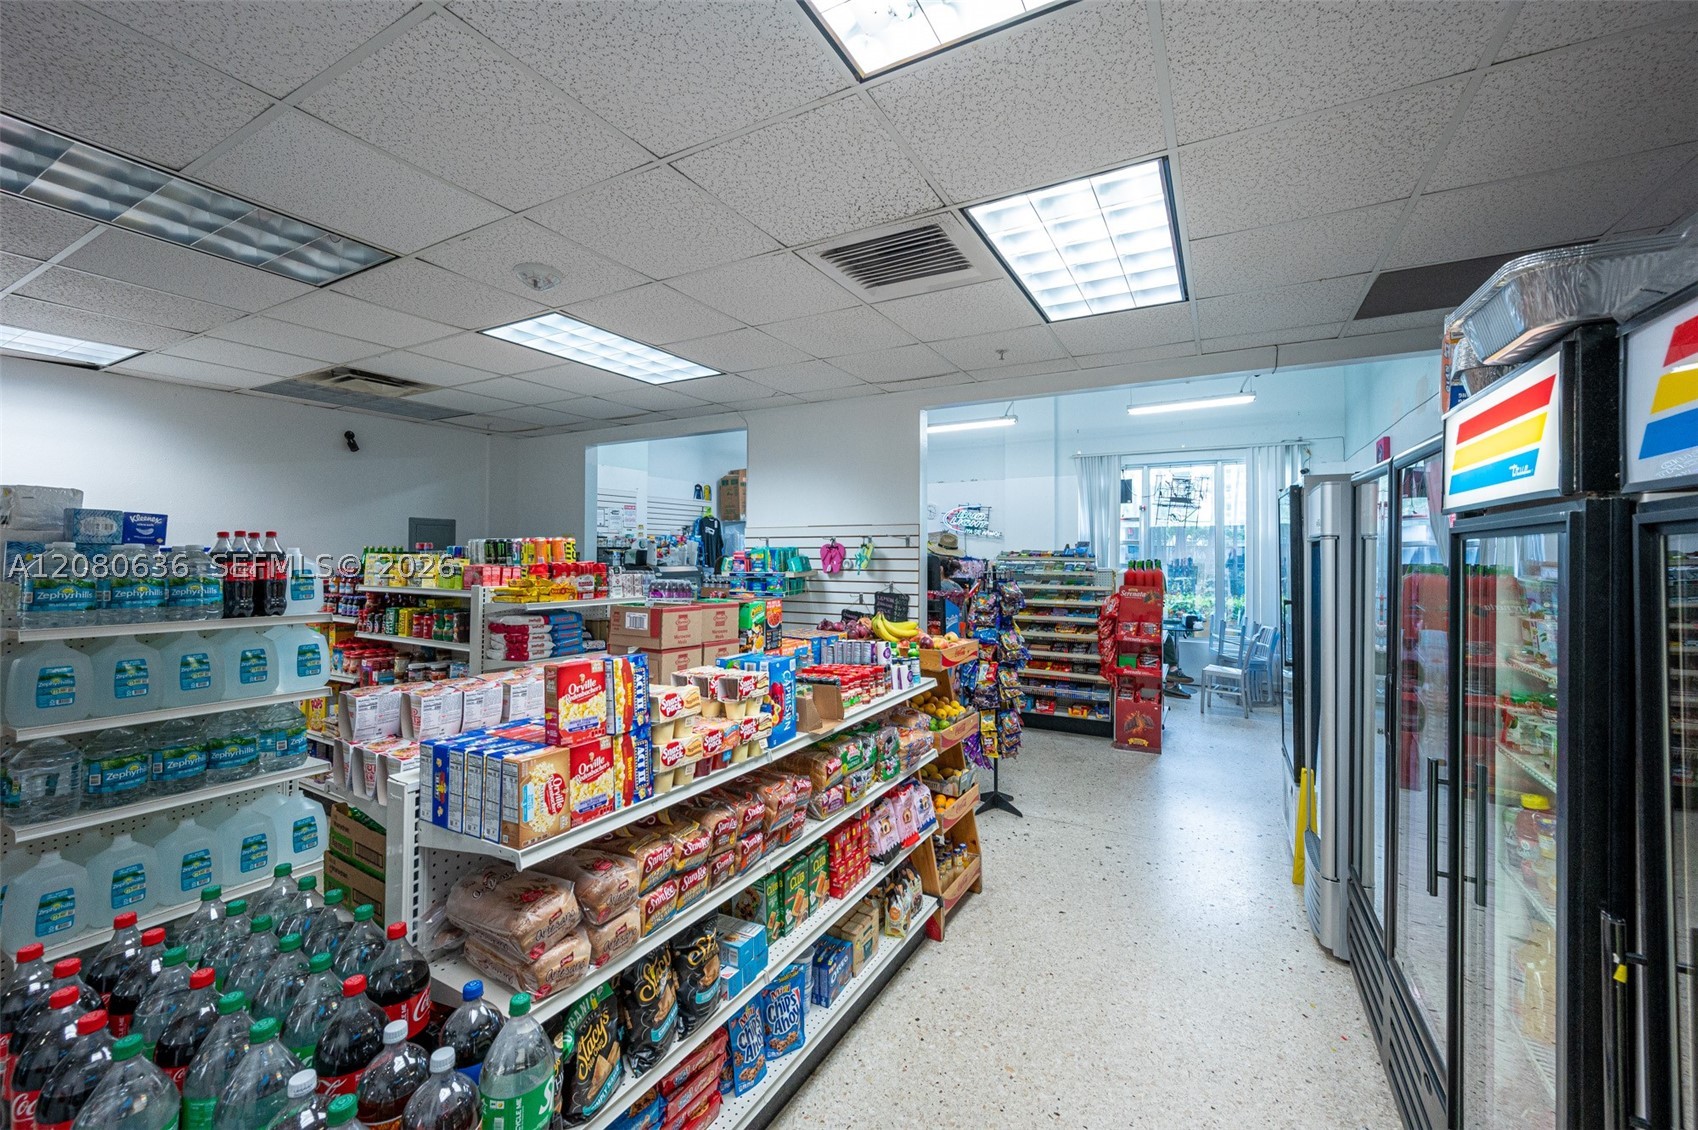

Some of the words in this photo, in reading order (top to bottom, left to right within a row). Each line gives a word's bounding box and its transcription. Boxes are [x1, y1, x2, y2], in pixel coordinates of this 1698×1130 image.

[129, 514, 163, 524] Kleenex
[37, 587, 93, 599] Zephyrhills
[115, 586, 163, 598] Zephyrhills
[172, 586, 217, 597] Zephyrhills
[568, 679, 597, 695] Orville
[740, 678, 754, 689] Snack
[660, 695, 682, 711] Snack
[740, 721, 755, 732] Snack
[704, 732, 722, 746] Snack
[211, 747, 254, 759] Zephyrhills
[662, 744, 683, 759] Snack
[578, 756, 605, 775] Orville
[552, 777, 564, 809] Orville
[715, 821, 728, 835] Sara
[726, 818, 738, 829] Lee
[684, 840, 701, 856] Sara
[645, 853, 662, 873] Sara
[661, 846, 674, 862] Lee
[682, 873, 698, 891] Sara
[696, 864, 707, 880] Lee
[647, 894, 666, 914] Sara
[664, 885, 678, 900] Lee
[766, 992, 798, 1025] Chips
[737, 1014, 761, 1051] Chips
[577, 1010, 610, 1081] Stacy's
